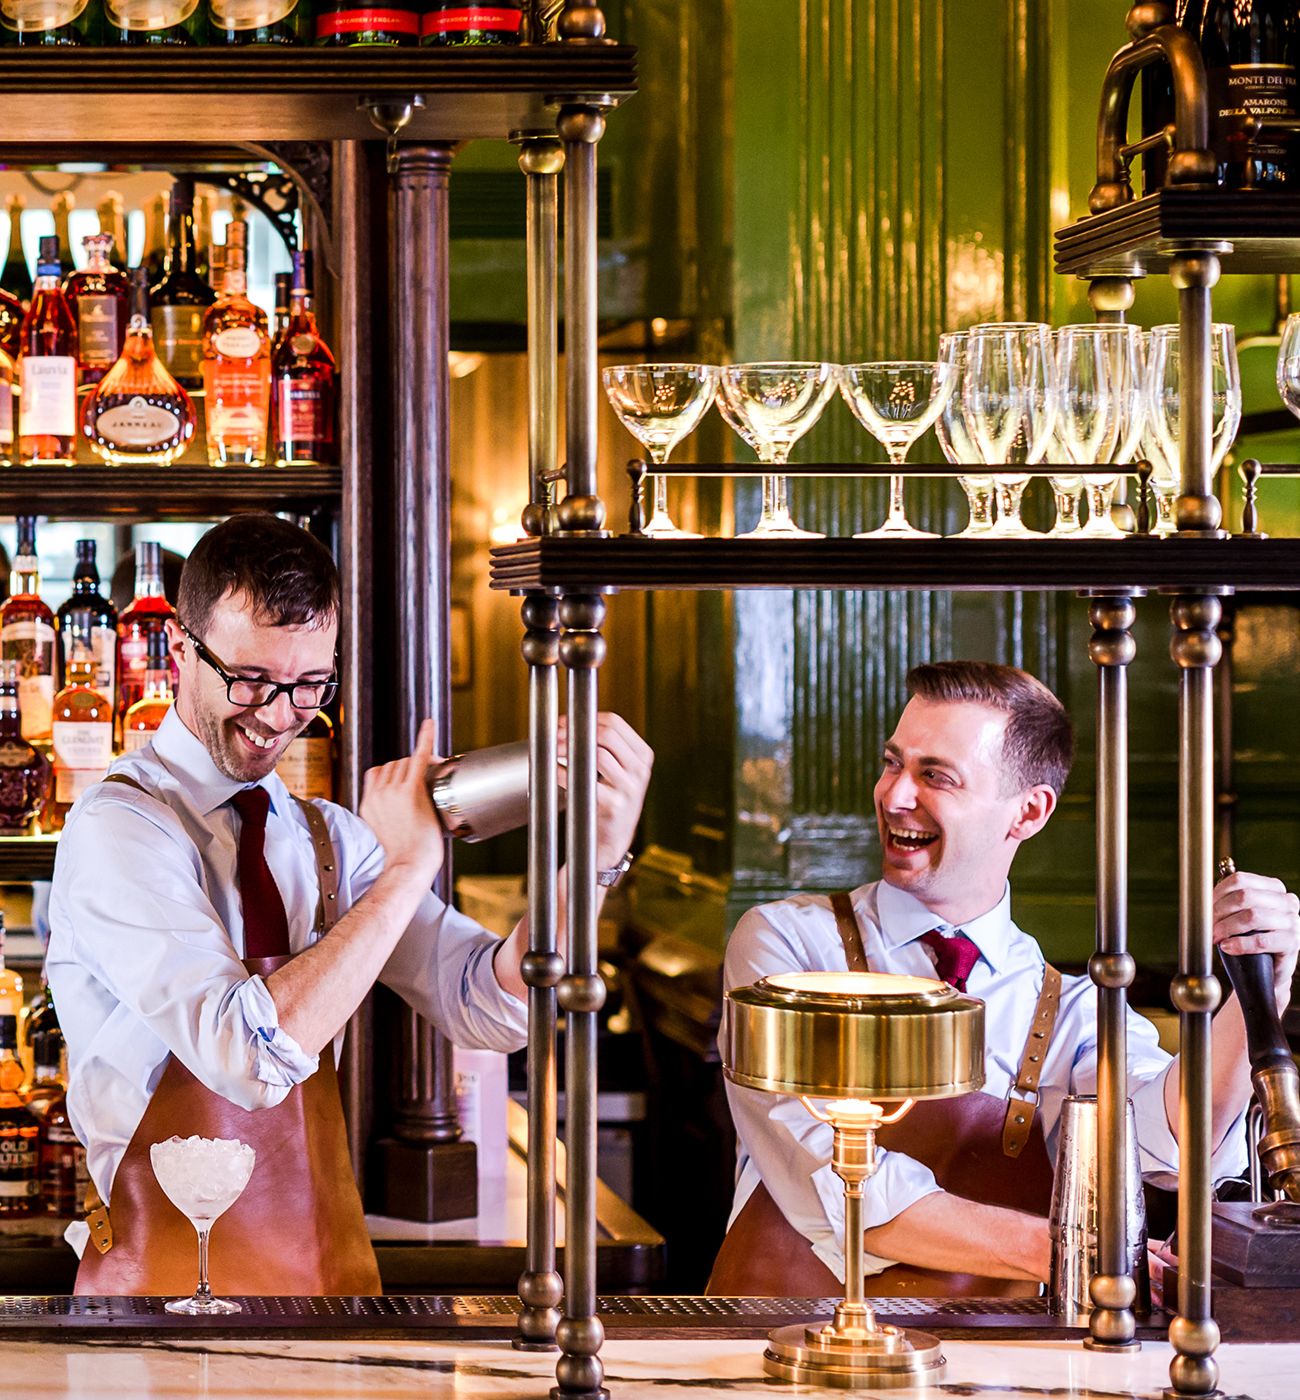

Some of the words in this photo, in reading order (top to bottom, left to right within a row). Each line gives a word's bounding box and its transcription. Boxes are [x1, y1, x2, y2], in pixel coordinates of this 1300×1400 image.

[1228, 75, 1265, 86] MONTE
[1267, 75, 1283, 85] DEL
[1242, 98, 1288, 107] AMARONE
[1218, 108, 1247, 117] DELLA
[0, 1140, 28, 1153] OLD
